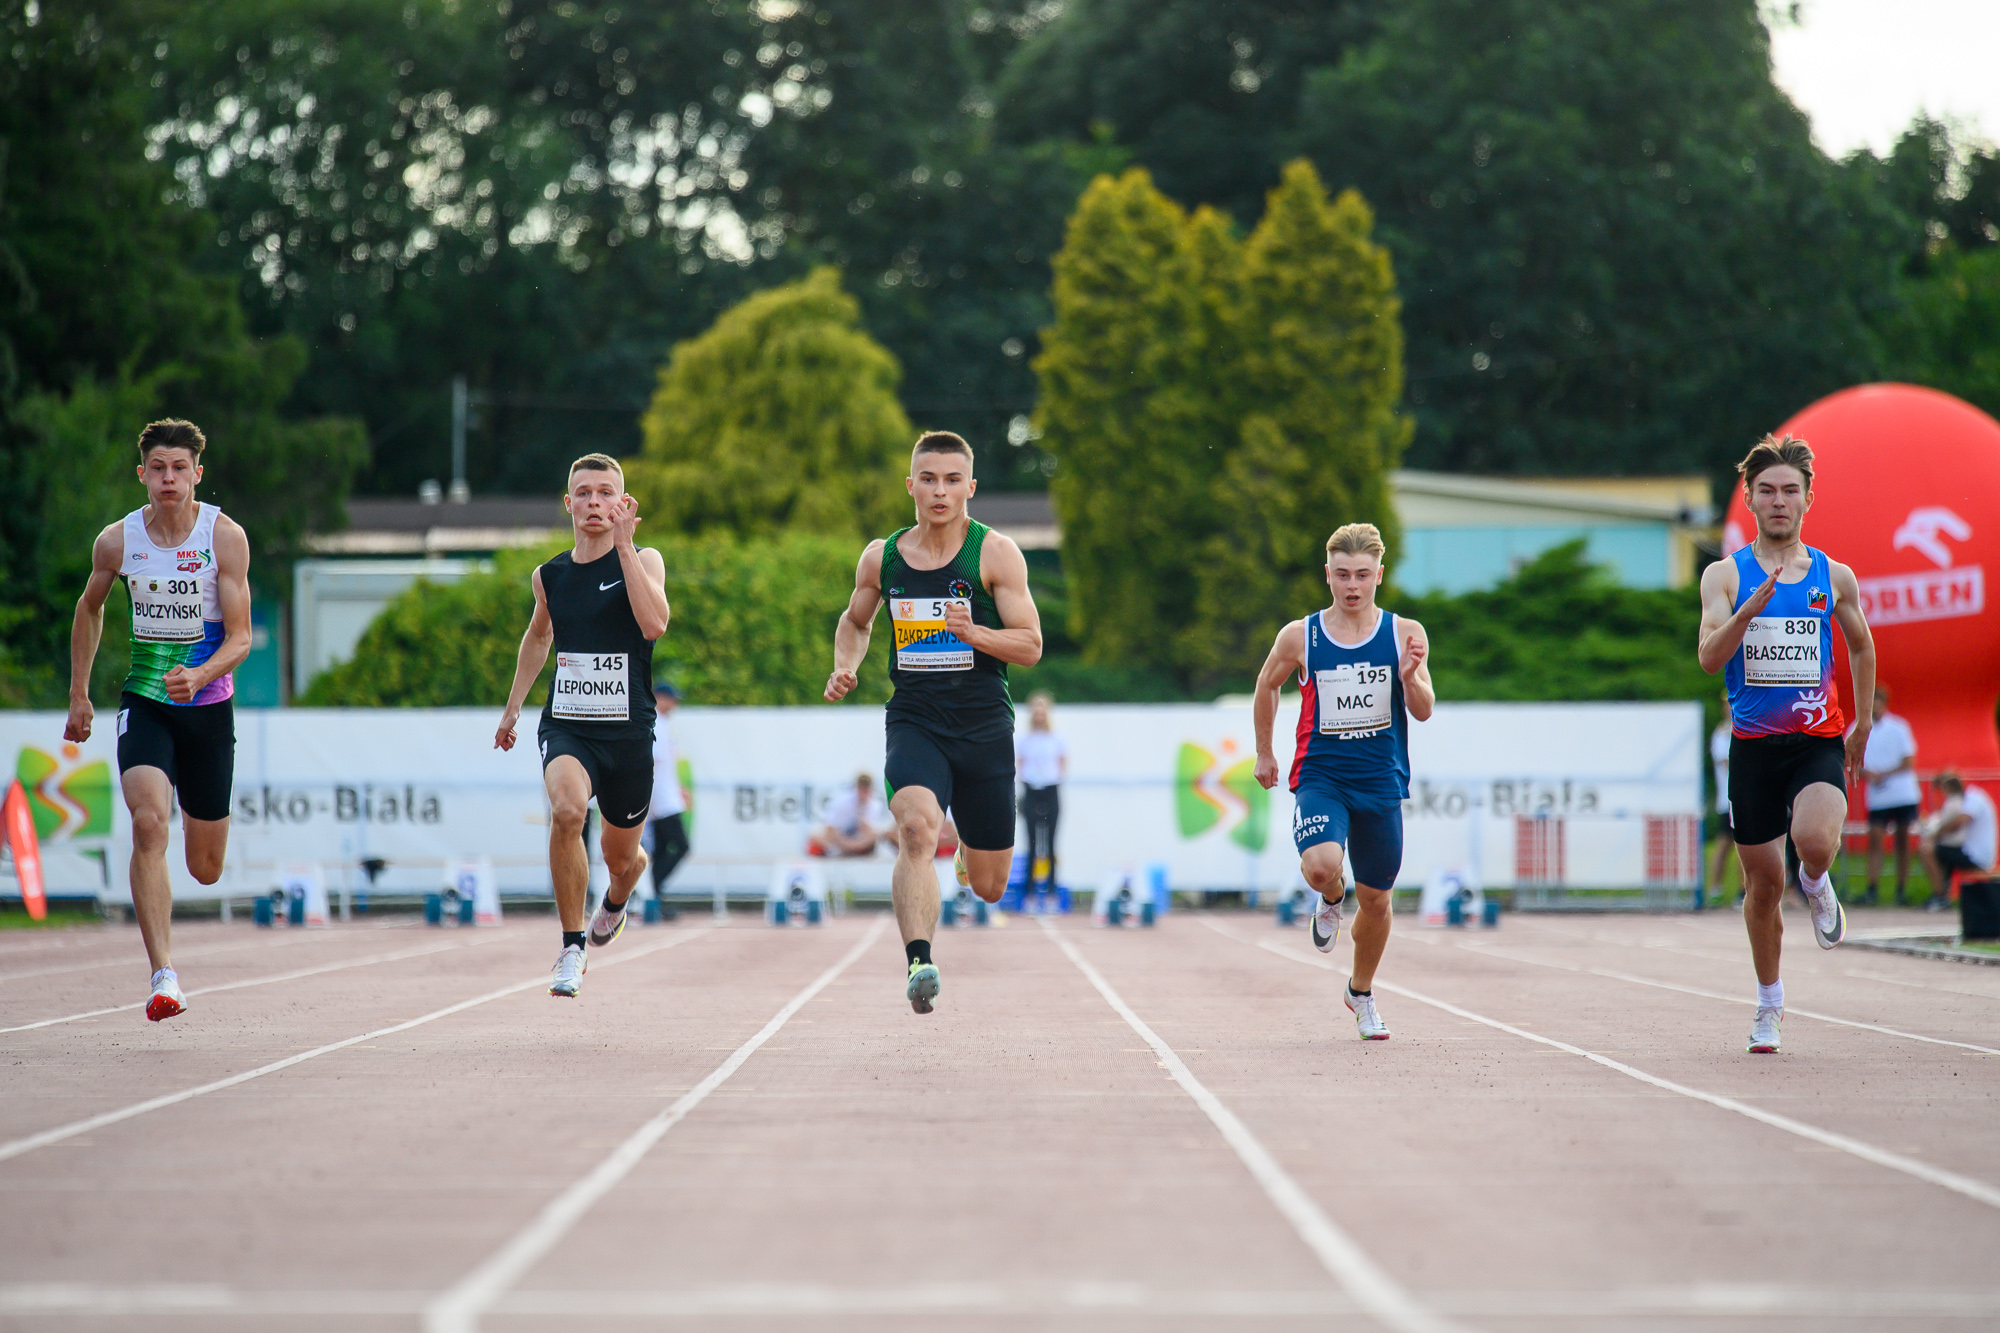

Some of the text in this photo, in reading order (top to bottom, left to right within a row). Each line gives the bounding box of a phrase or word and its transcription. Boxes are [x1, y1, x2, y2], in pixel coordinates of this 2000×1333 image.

[176, 550, 197, 559] MKS
[168, 579, 200, 595] 301
[134, 602, 202, 620] BUCZYŃSKI
[1785, 619, 1816, 635] 830
[1746, 645, 1818, 661] BŁASZCZYK
[593, 656, 623, 671] 145
[1357, 668, 1387, 684] 195
[558, 679, 626, 696] LEPIONKA
[1337, 694, 1374, 710] MAC
